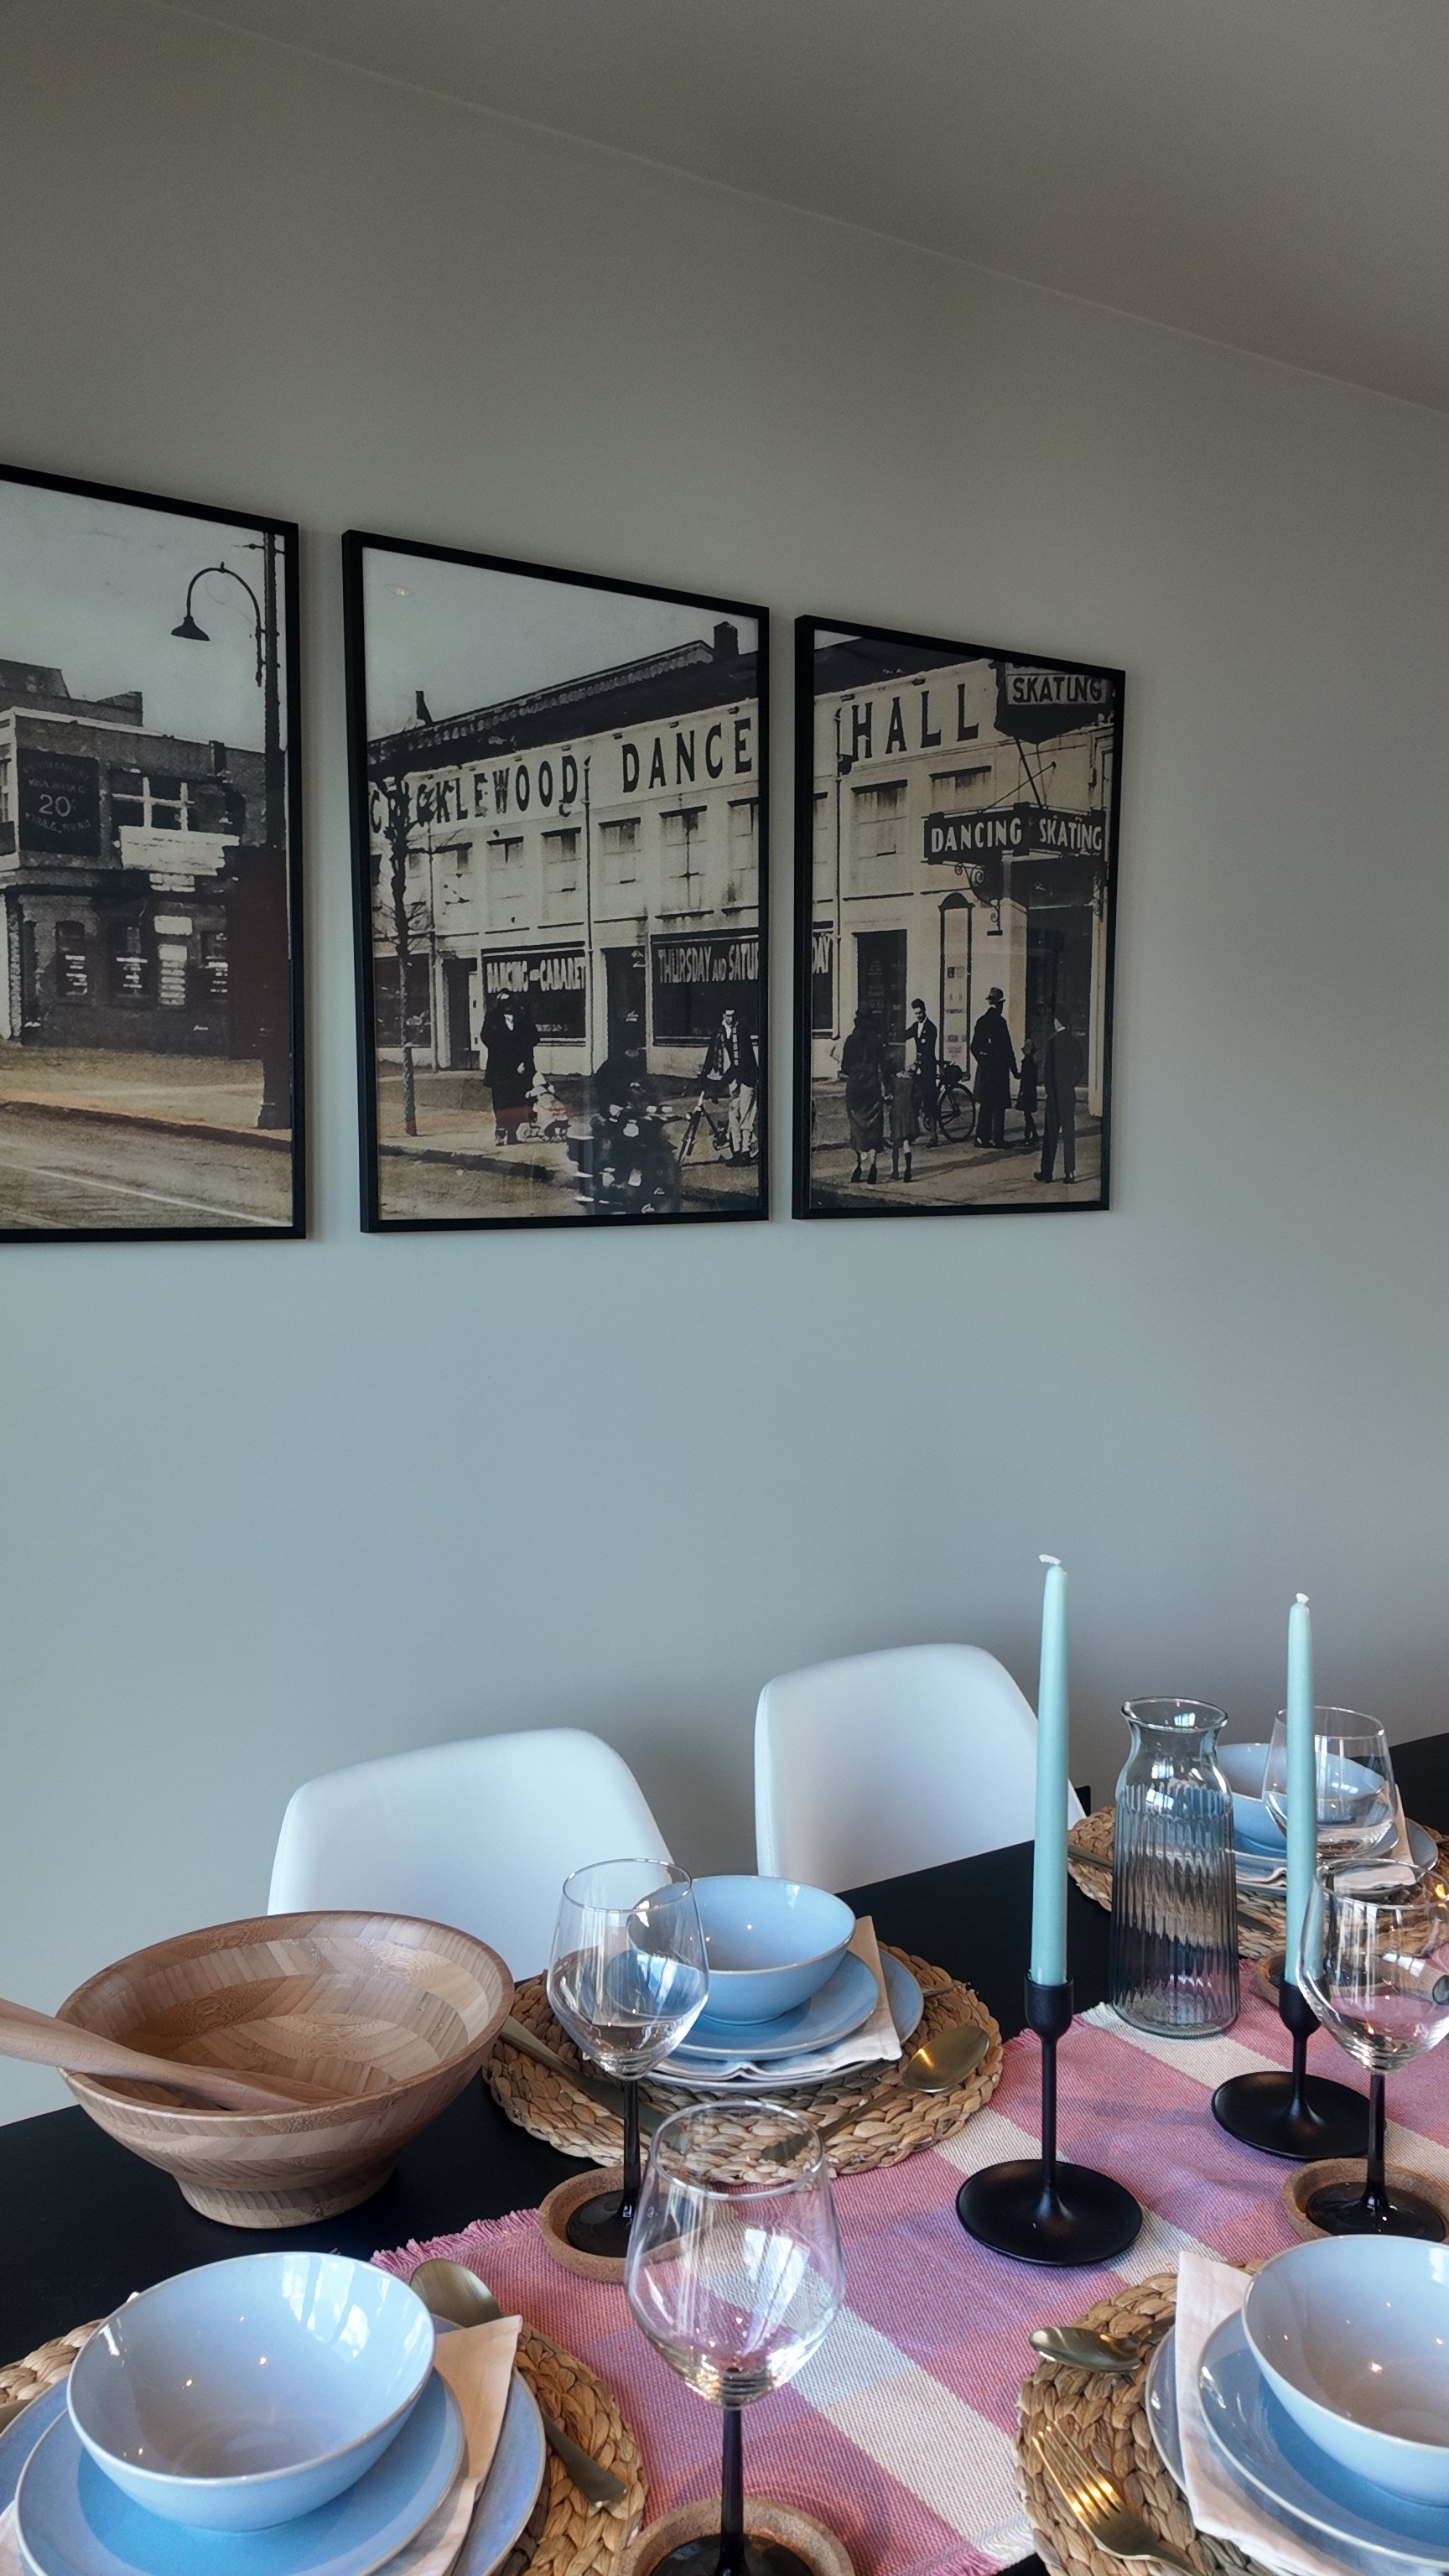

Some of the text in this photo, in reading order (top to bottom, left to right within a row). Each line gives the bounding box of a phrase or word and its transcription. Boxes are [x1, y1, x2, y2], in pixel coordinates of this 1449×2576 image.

[1012, 676, 1102, 703] SKATING
[852, 683, 979, 763] HALL
[371, 716, 753, 833] CCKLEWOOD DANCE
[931, 816, 1103, 854] DANCING SKATING
[657, 946, 712, 984] THURSDAY
